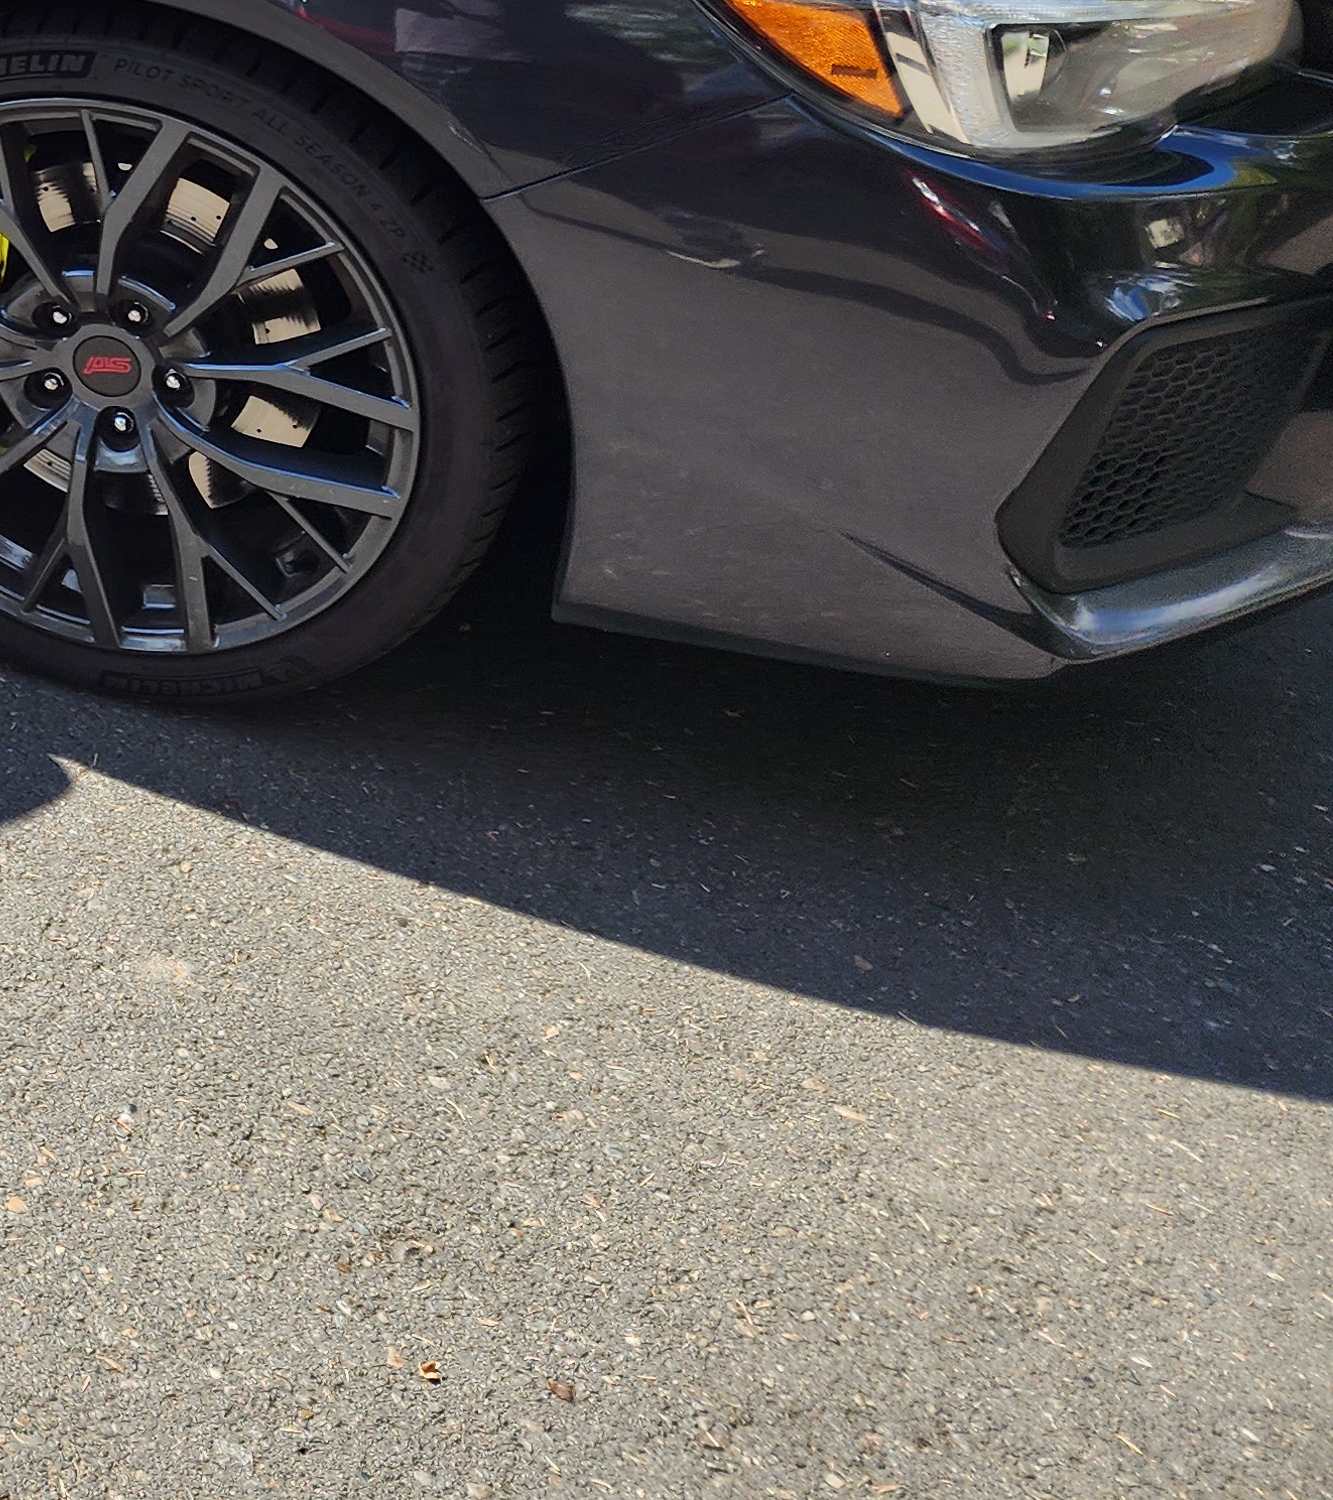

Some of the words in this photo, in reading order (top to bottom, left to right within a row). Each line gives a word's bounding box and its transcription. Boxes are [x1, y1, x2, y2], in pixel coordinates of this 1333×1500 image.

[114, 58, 175, 82] PILOT
[252, 108, 286, 135] ALL
[293, 136, 371, 196] SEASON
